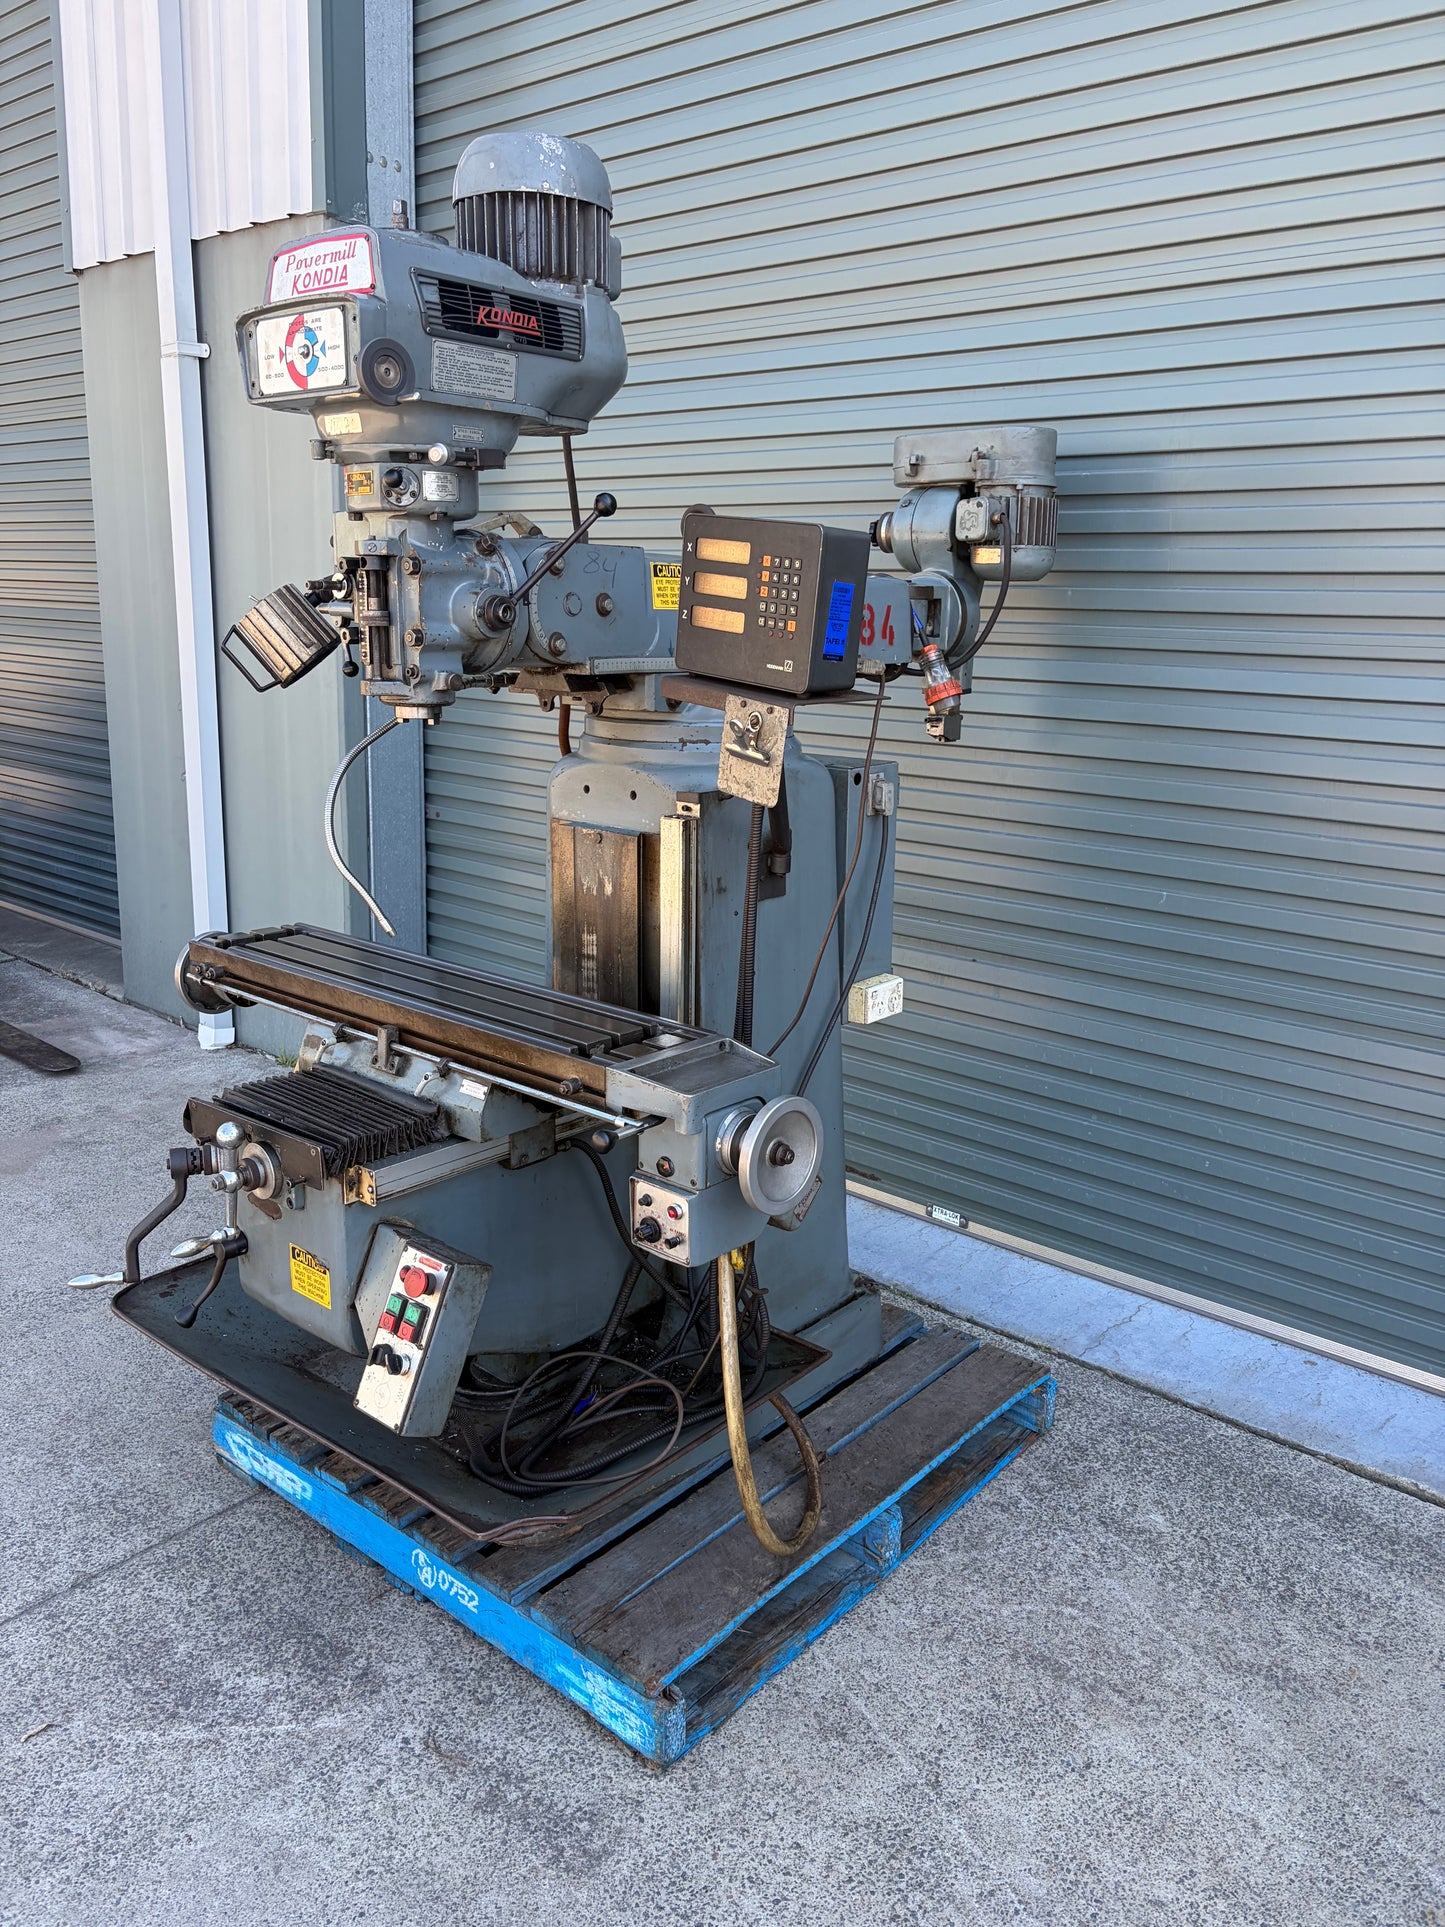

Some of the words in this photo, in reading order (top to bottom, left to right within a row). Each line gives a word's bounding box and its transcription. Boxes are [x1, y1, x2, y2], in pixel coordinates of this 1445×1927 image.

[285, 241, 357, 273] Powermill
[291, 264, 348, 296] KONDIA
[477, 306, 539, 330] KONDIA
[687, 543, 692, 552] X
[583, 551, 617, 589] 84
[657, 565, 682, 577] CAUTIO
[774, 558, 779, 566] 7
[685, 576, 690, 586] Y
[682, 609, 688, 619] Z
[859, 603, 895, 647] 84
[295, 1268, 305, 1278] MUST
[314, 1278, 326, 1288] WORN
[303, 1266, 326, 1282] PROTECTION
[295, 1275, 305, 1284] WHEN
[307, 1281, 327, 1296] OPERATING
[298, 1282, 306, 1291] THIS
[308, 1288, 324, 1300] MACHINE
[438, 1570, 479, 1614] 0752
